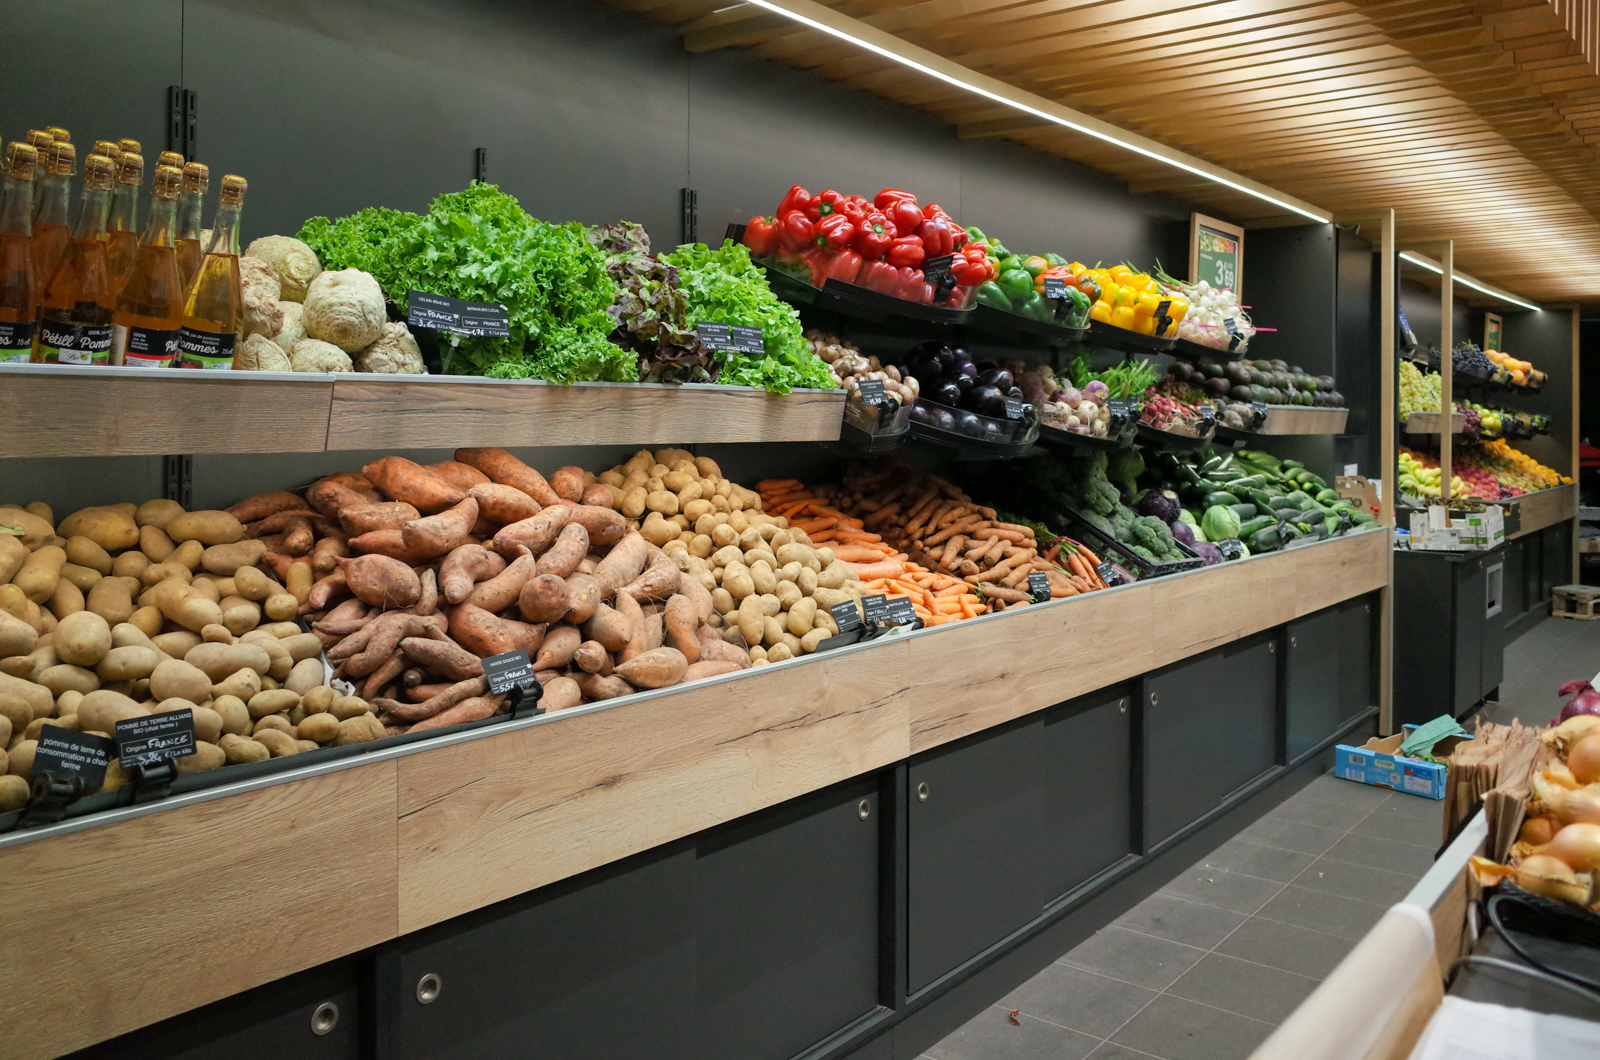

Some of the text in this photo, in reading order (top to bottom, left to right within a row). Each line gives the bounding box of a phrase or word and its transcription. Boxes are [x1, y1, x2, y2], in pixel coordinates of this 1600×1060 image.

[1215, 260, 1224, 285] 3
[1225, 270, 1234, 288] 69
[427, 310, 454, 322] FRANCE
[42, 329, 75, 347] Pétill
[504, 669, 526, 679] FRANCE
[116, 722, 139, 731] POMME
[149, 716, 168, 725] TERRE
[43, 738, 69, 749] pomme
[80, 745, 95, 755] terre
[126, 735, 188, 753] Origine FRANCE
[36, 747, 85, 762] consommation
[91, 758, 108, 766] chair
[61, 760, 81, 770] ferme
